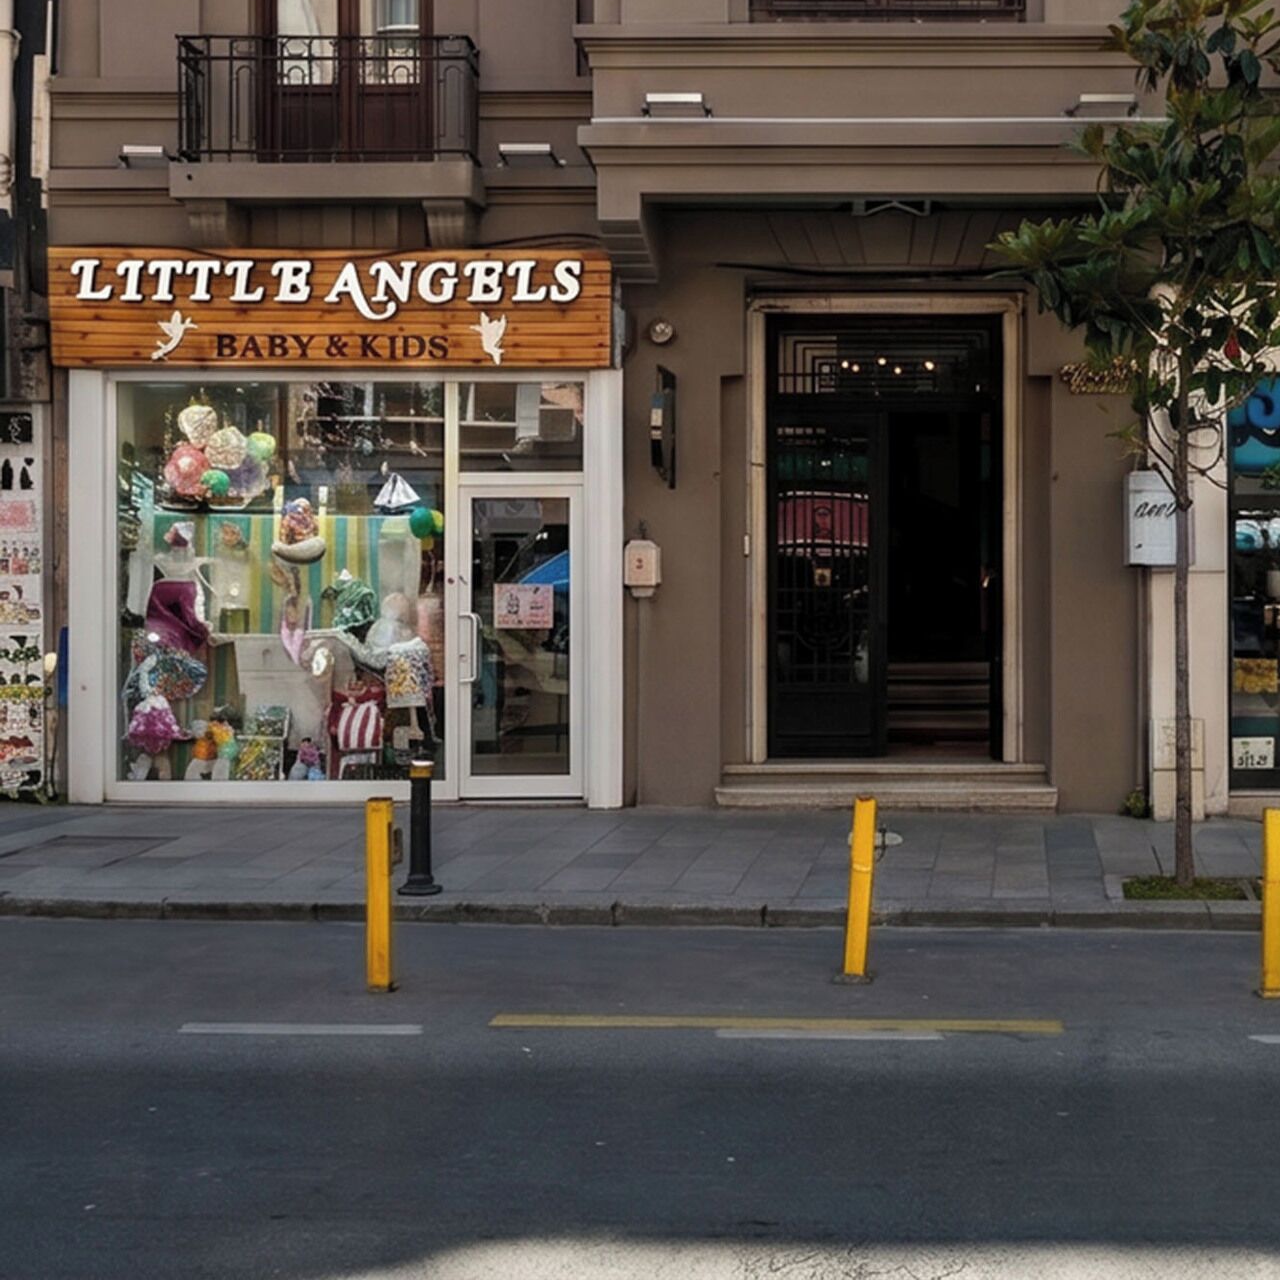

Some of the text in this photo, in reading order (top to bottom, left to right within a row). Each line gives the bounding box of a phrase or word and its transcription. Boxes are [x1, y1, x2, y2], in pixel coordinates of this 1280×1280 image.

[70, 258, 583, 321] LITTLE ANGELS
[215, 333, 450, 360] BABY & KIDS
